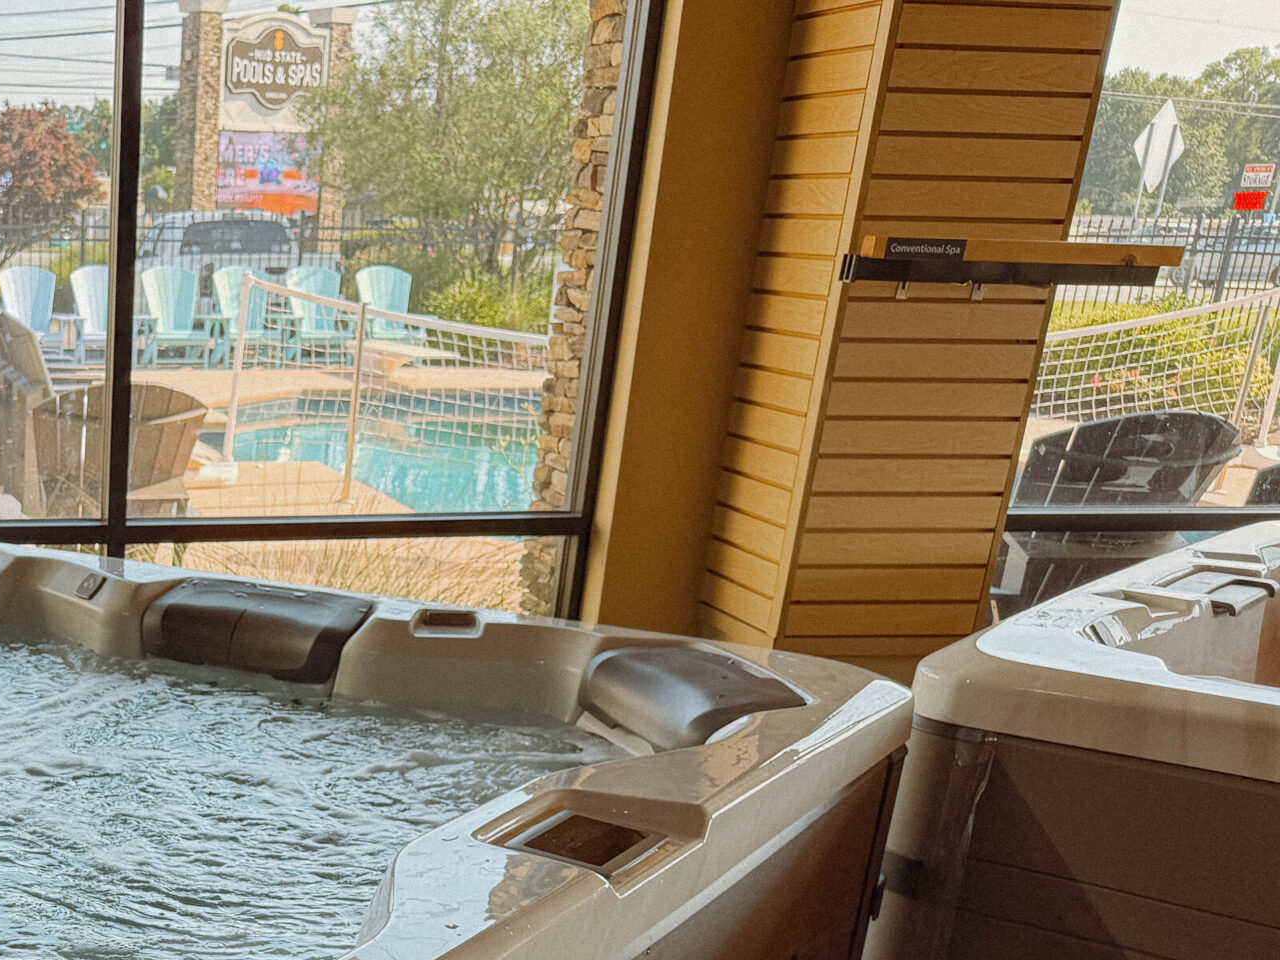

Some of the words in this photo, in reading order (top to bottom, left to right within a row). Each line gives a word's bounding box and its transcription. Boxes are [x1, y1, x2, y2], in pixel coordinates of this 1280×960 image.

[274, 50, 302, 64] STATE
[232, 56, 274, 85] POOLS
[275, 66, 287, 84] &
[288, 62, 321, 88] SPAS
[890, 243, 945, 254] Conventional
[945, 244, 961, 256] Spa
